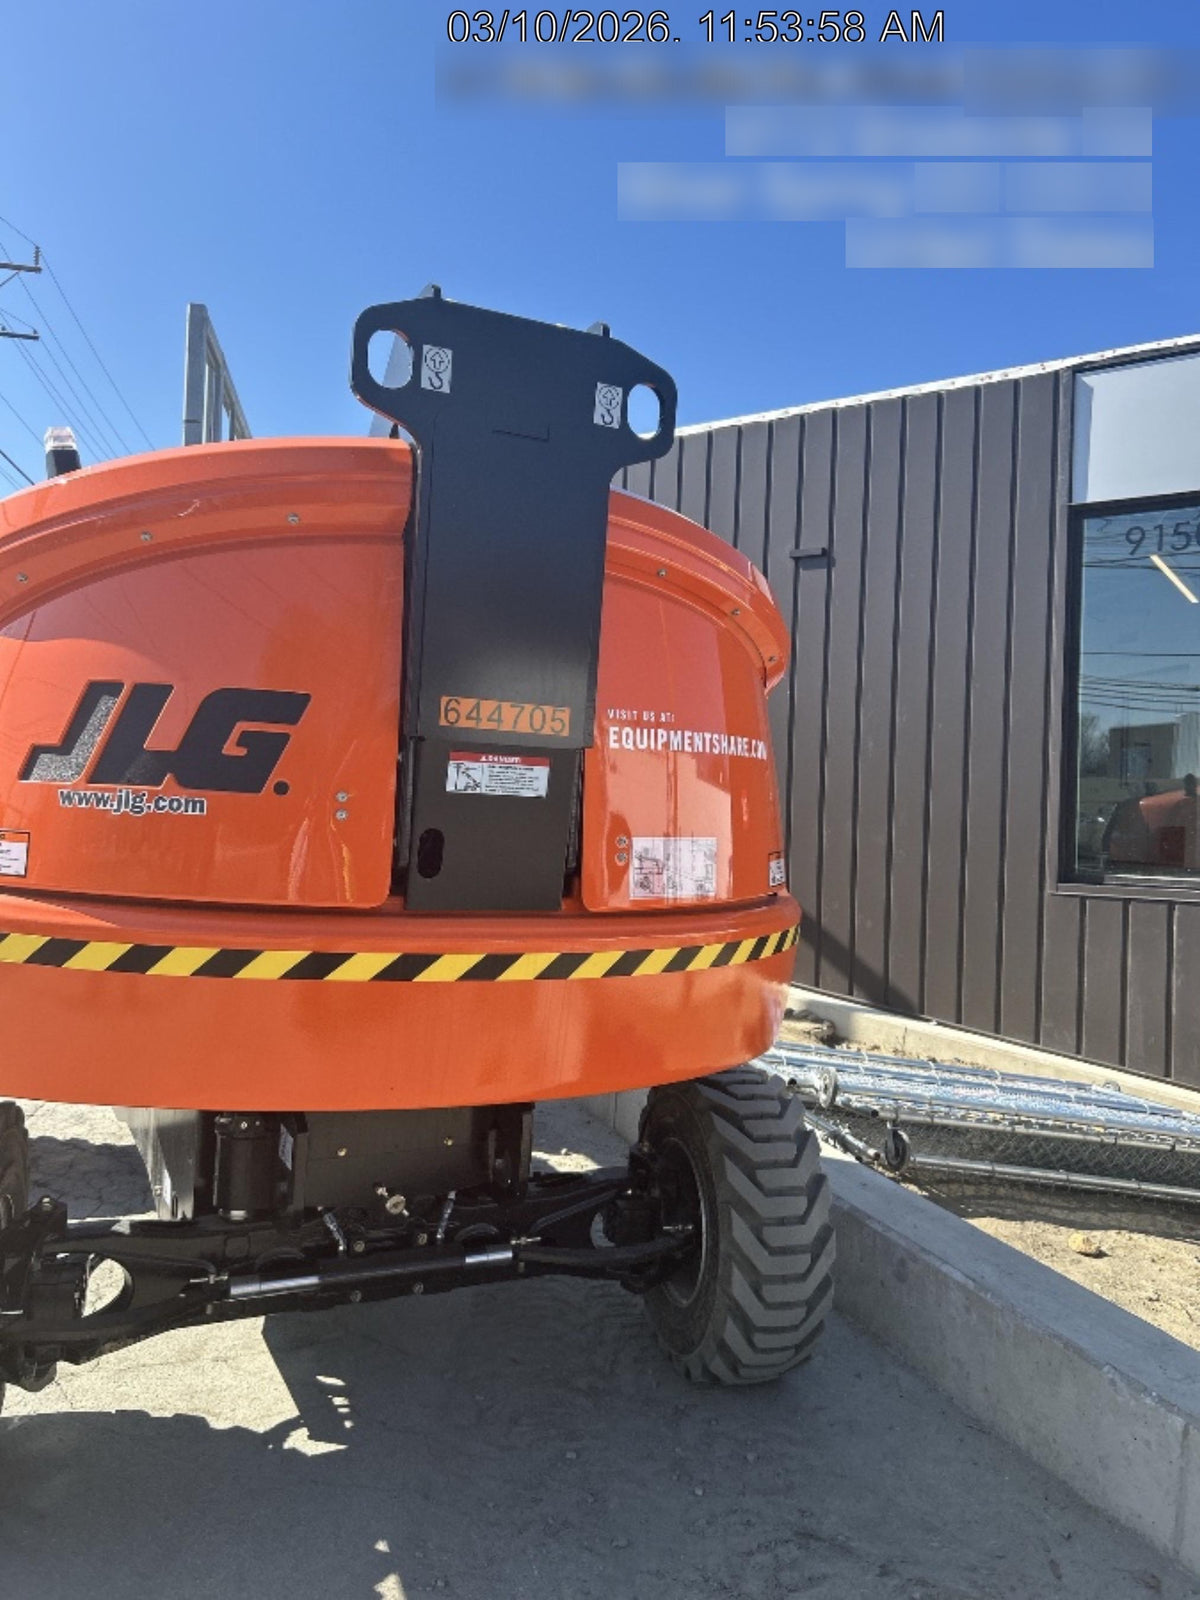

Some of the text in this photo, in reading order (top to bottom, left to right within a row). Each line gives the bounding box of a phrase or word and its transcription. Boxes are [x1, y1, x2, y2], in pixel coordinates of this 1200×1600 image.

[443, 697, 567, 734] 644705
[607, 708, 638, 721] VISIT
[642, 710, 656, 722] US
[58, 788, 207, 816] www.jlg.com
